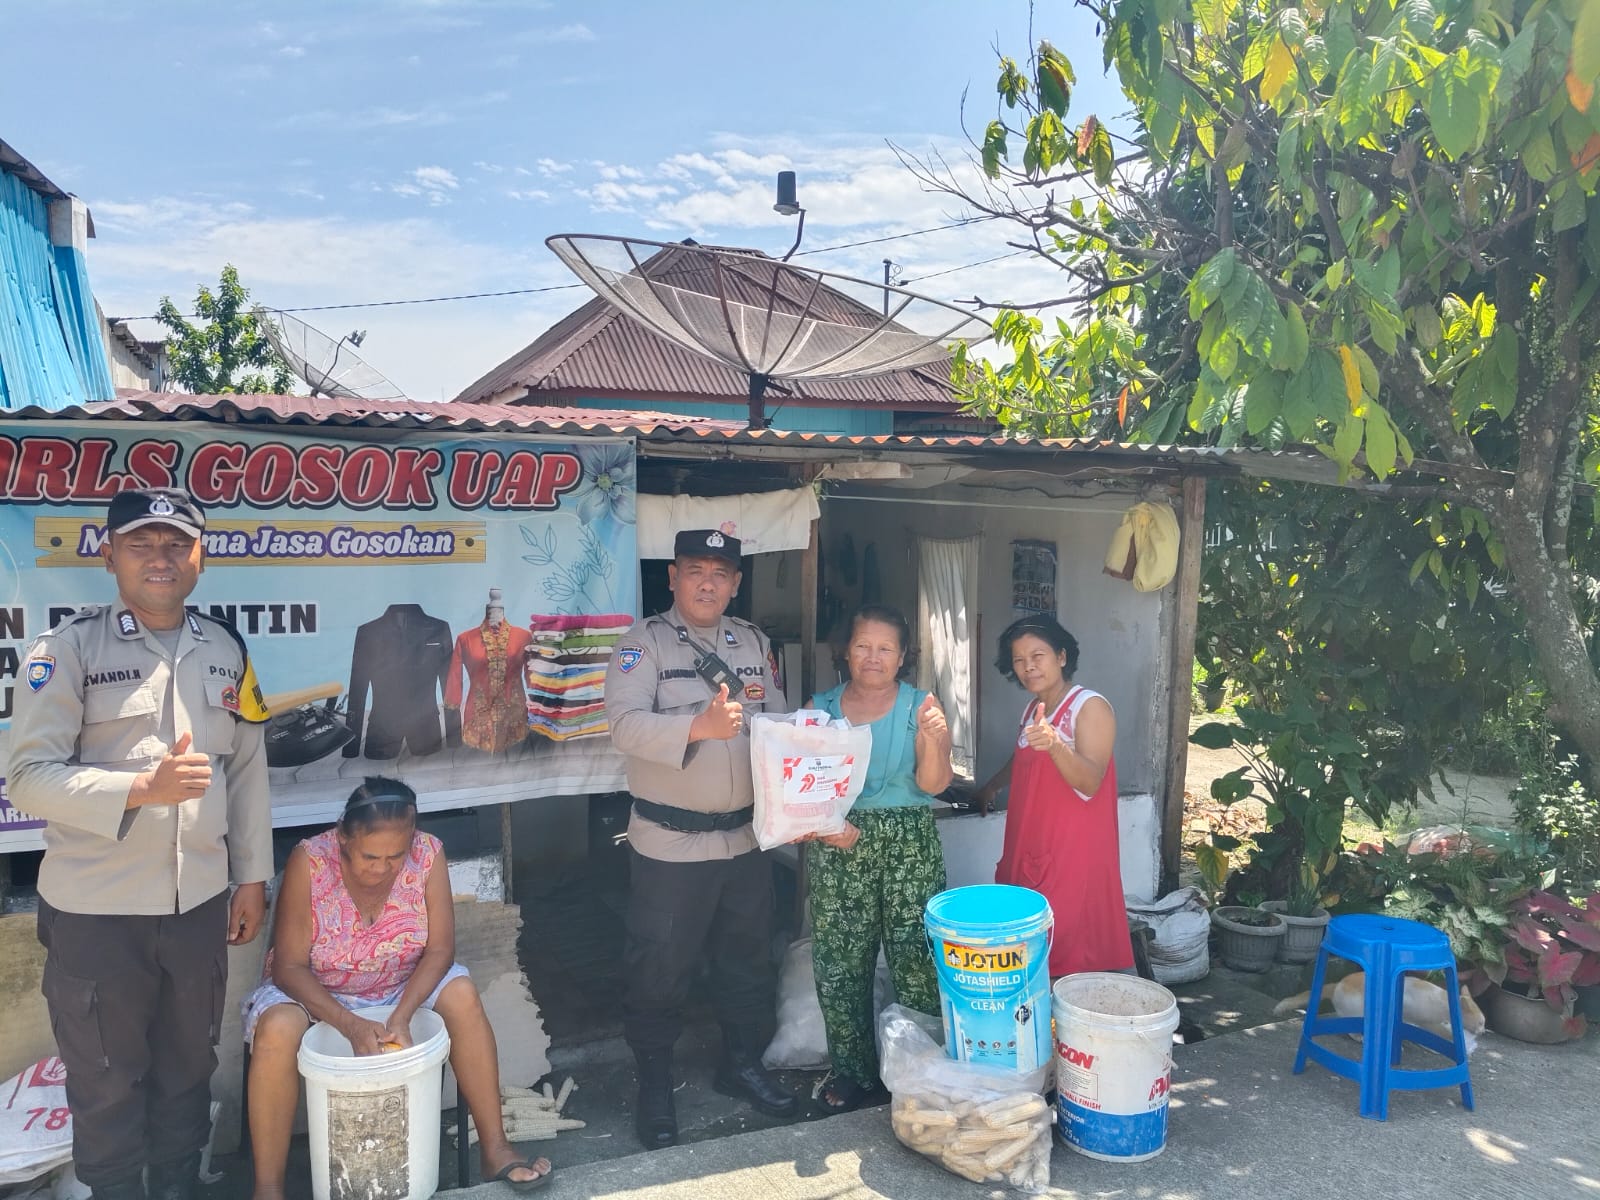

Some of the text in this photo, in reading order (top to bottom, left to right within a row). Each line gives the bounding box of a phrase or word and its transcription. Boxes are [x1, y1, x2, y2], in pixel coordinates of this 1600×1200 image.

[188, 443, 438, 507] GOSOK
[447, 449, 583, 507] UAP
[253, 529, 322, 558] Jasa
[330, 530, 453, 555] Gosokan
[963, 950, 1023, 969] JOTUN
[953, 973, 1021, 987] JOTASHIELD
[970, 1001, 1006, 1011] CLEAN
[1057, 1043, 1094, 1069] GON
[23, 1107, 71, 1131] 78
